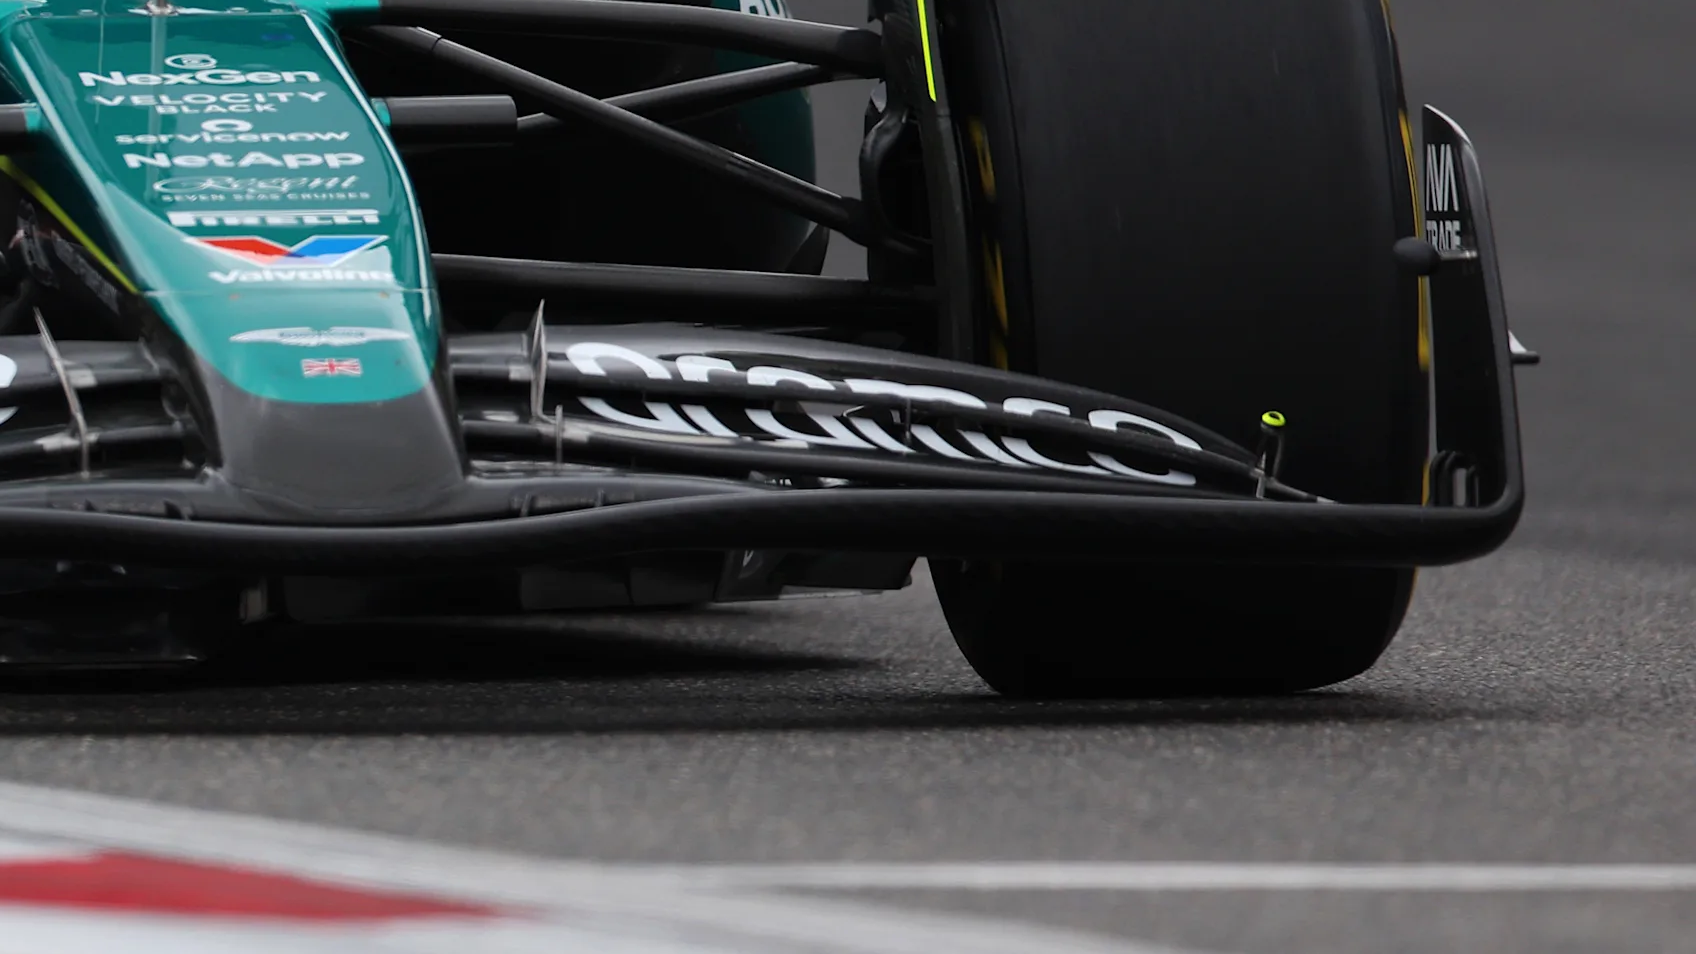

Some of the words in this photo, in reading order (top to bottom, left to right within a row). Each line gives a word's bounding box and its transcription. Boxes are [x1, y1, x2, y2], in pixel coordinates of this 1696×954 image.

[78, 69, 322, 87] NexGen
[93, 91, 328, 106] VELOCITY
[156, 103, 278, 115] BLACK
[115, 131, 350, 145] servicenow
[123, 152, 365, 169] NetApp
[166, 209, 380, 227] PIRELLI
[208, 268, 396, 284] Valvoline
